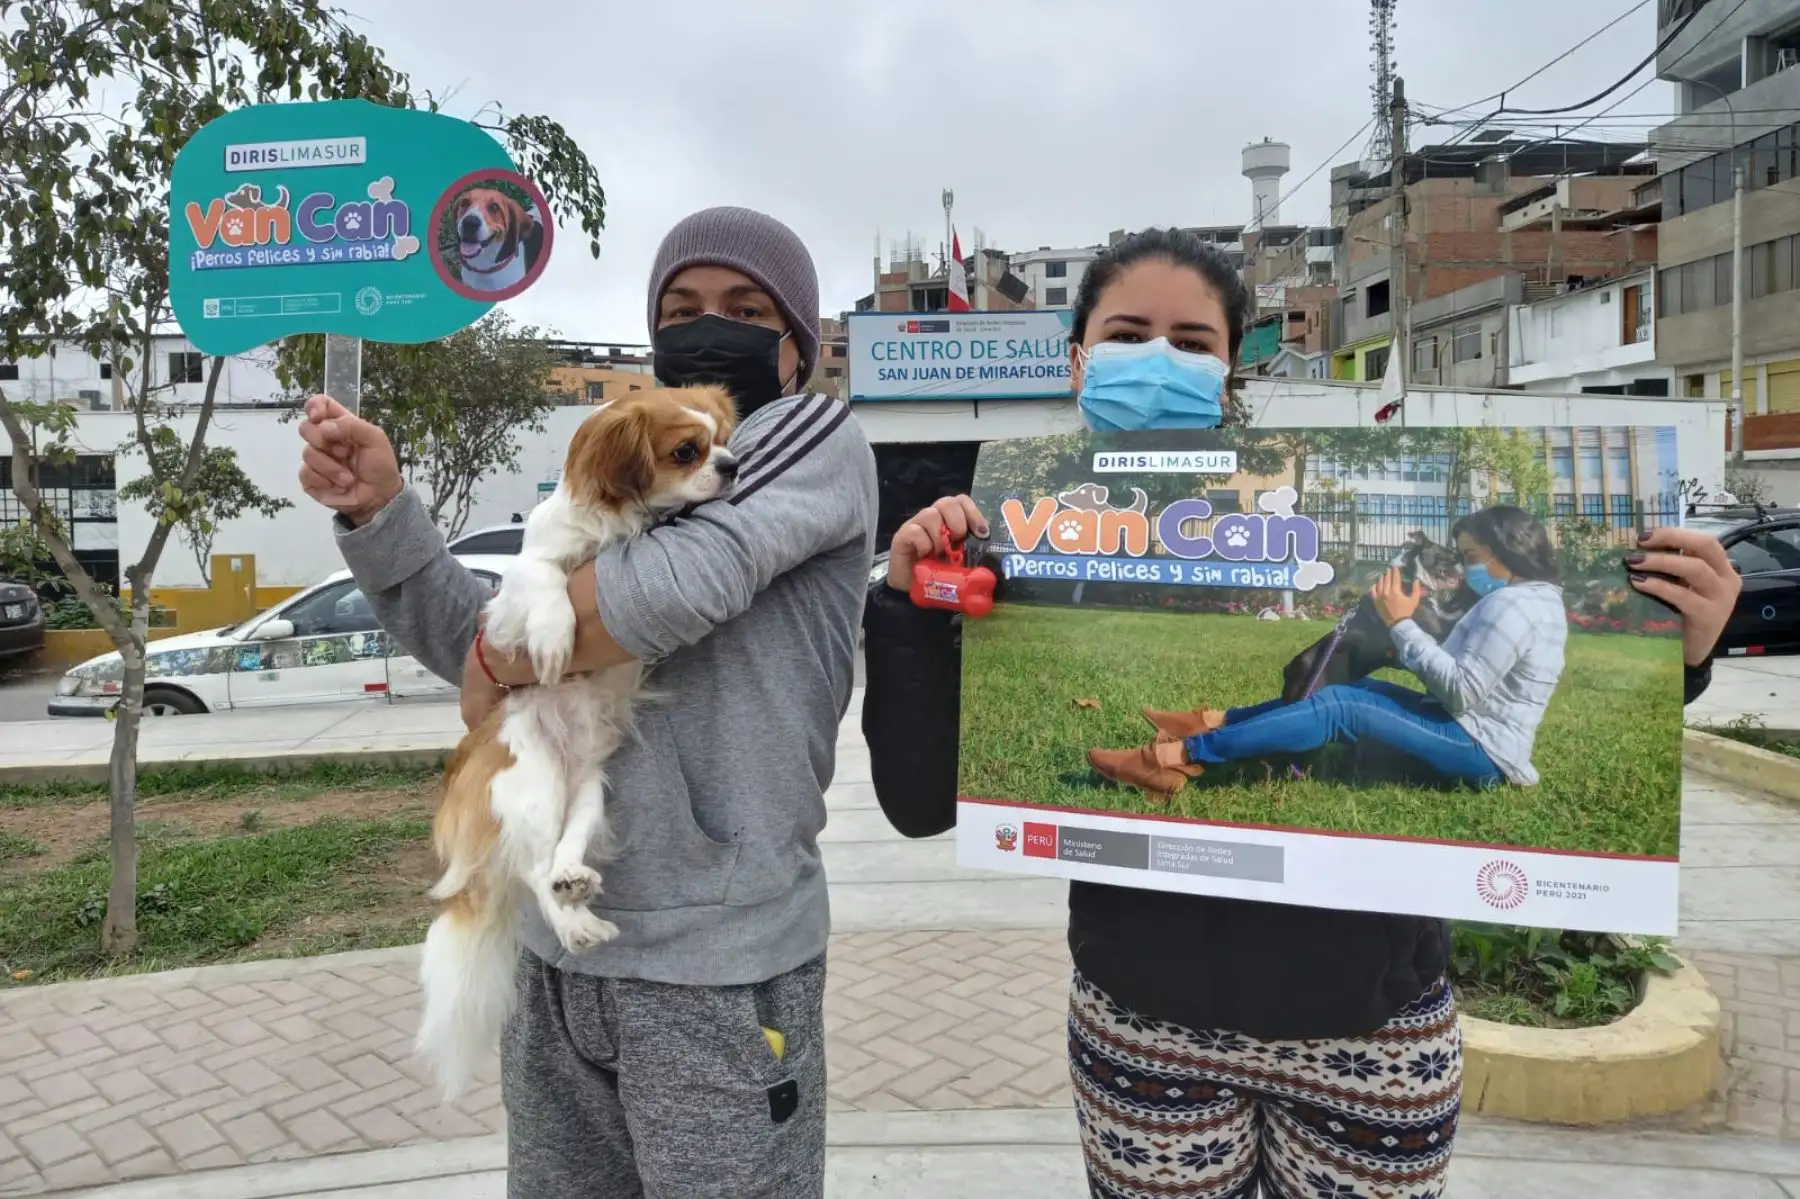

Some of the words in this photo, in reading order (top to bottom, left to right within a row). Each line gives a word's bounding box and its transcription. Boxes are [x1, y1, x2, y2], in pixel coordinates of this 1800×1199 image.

[190, 250, 243, 271] ¡Perros
[247, 248, 301, 265] felices
[306, 247, 316, 262] y
[348, 243, 390, 260] rabia!
[871, 340, 962, 361] CENTRO
[970, 340, 998, 360] DE
[878, 367, 908, 381] SAN
[912, 366, 951, 380] JUAN
[956, 365, 975, 379] DE
[979, 364, 1072, 379] MIRAFLORES
[1004, 553, 1078, 580] ¡Perros
[1086, 559, 1161, 581] felices
[1169, 563, 1183, 583] y
[1230, 565, 1290, 587] rabia!
[1027, 833, 1053, 847] PERÚ
[1063, 838, 1102, 850] Ministerio
[1063, 847, 1073, 856] de
[1075, 848, 1096, 858] Salud
[1536, 880, 1610, 893] BICENTENARIO
[1565, 891, 1586, 900] 2021
